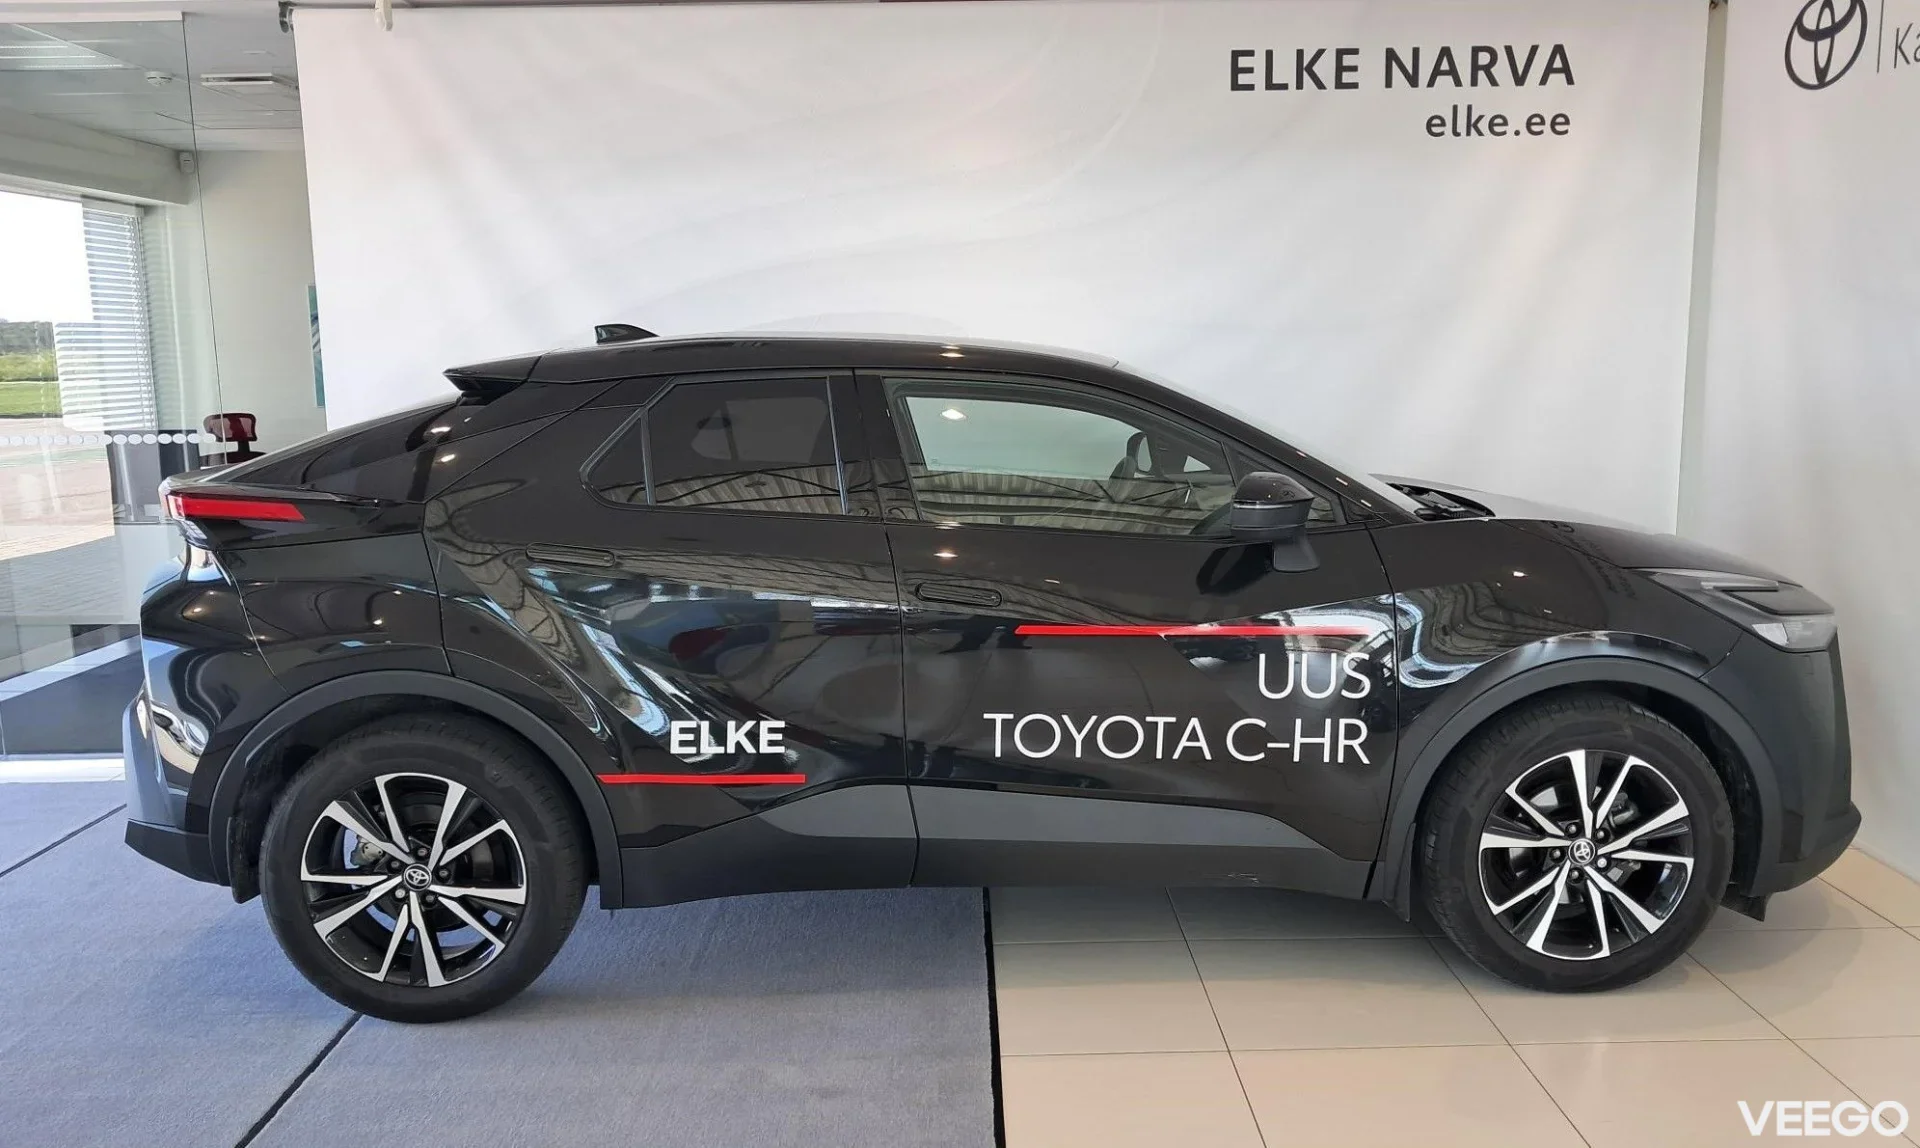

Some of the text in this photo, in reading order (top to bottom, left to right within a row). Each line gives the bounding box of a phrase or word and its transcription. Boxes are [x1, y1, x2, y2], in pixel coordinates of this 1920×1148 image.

[1230, 43, 1575, 91] ELKE NARVA
[1425, 104, 1571, 137] elke.ee
[1258, 652, 1371, 700] UUS
[669, 720, 786, 755] ELKE
[983, 713, 1370, 764] TOYOTA C-HR
